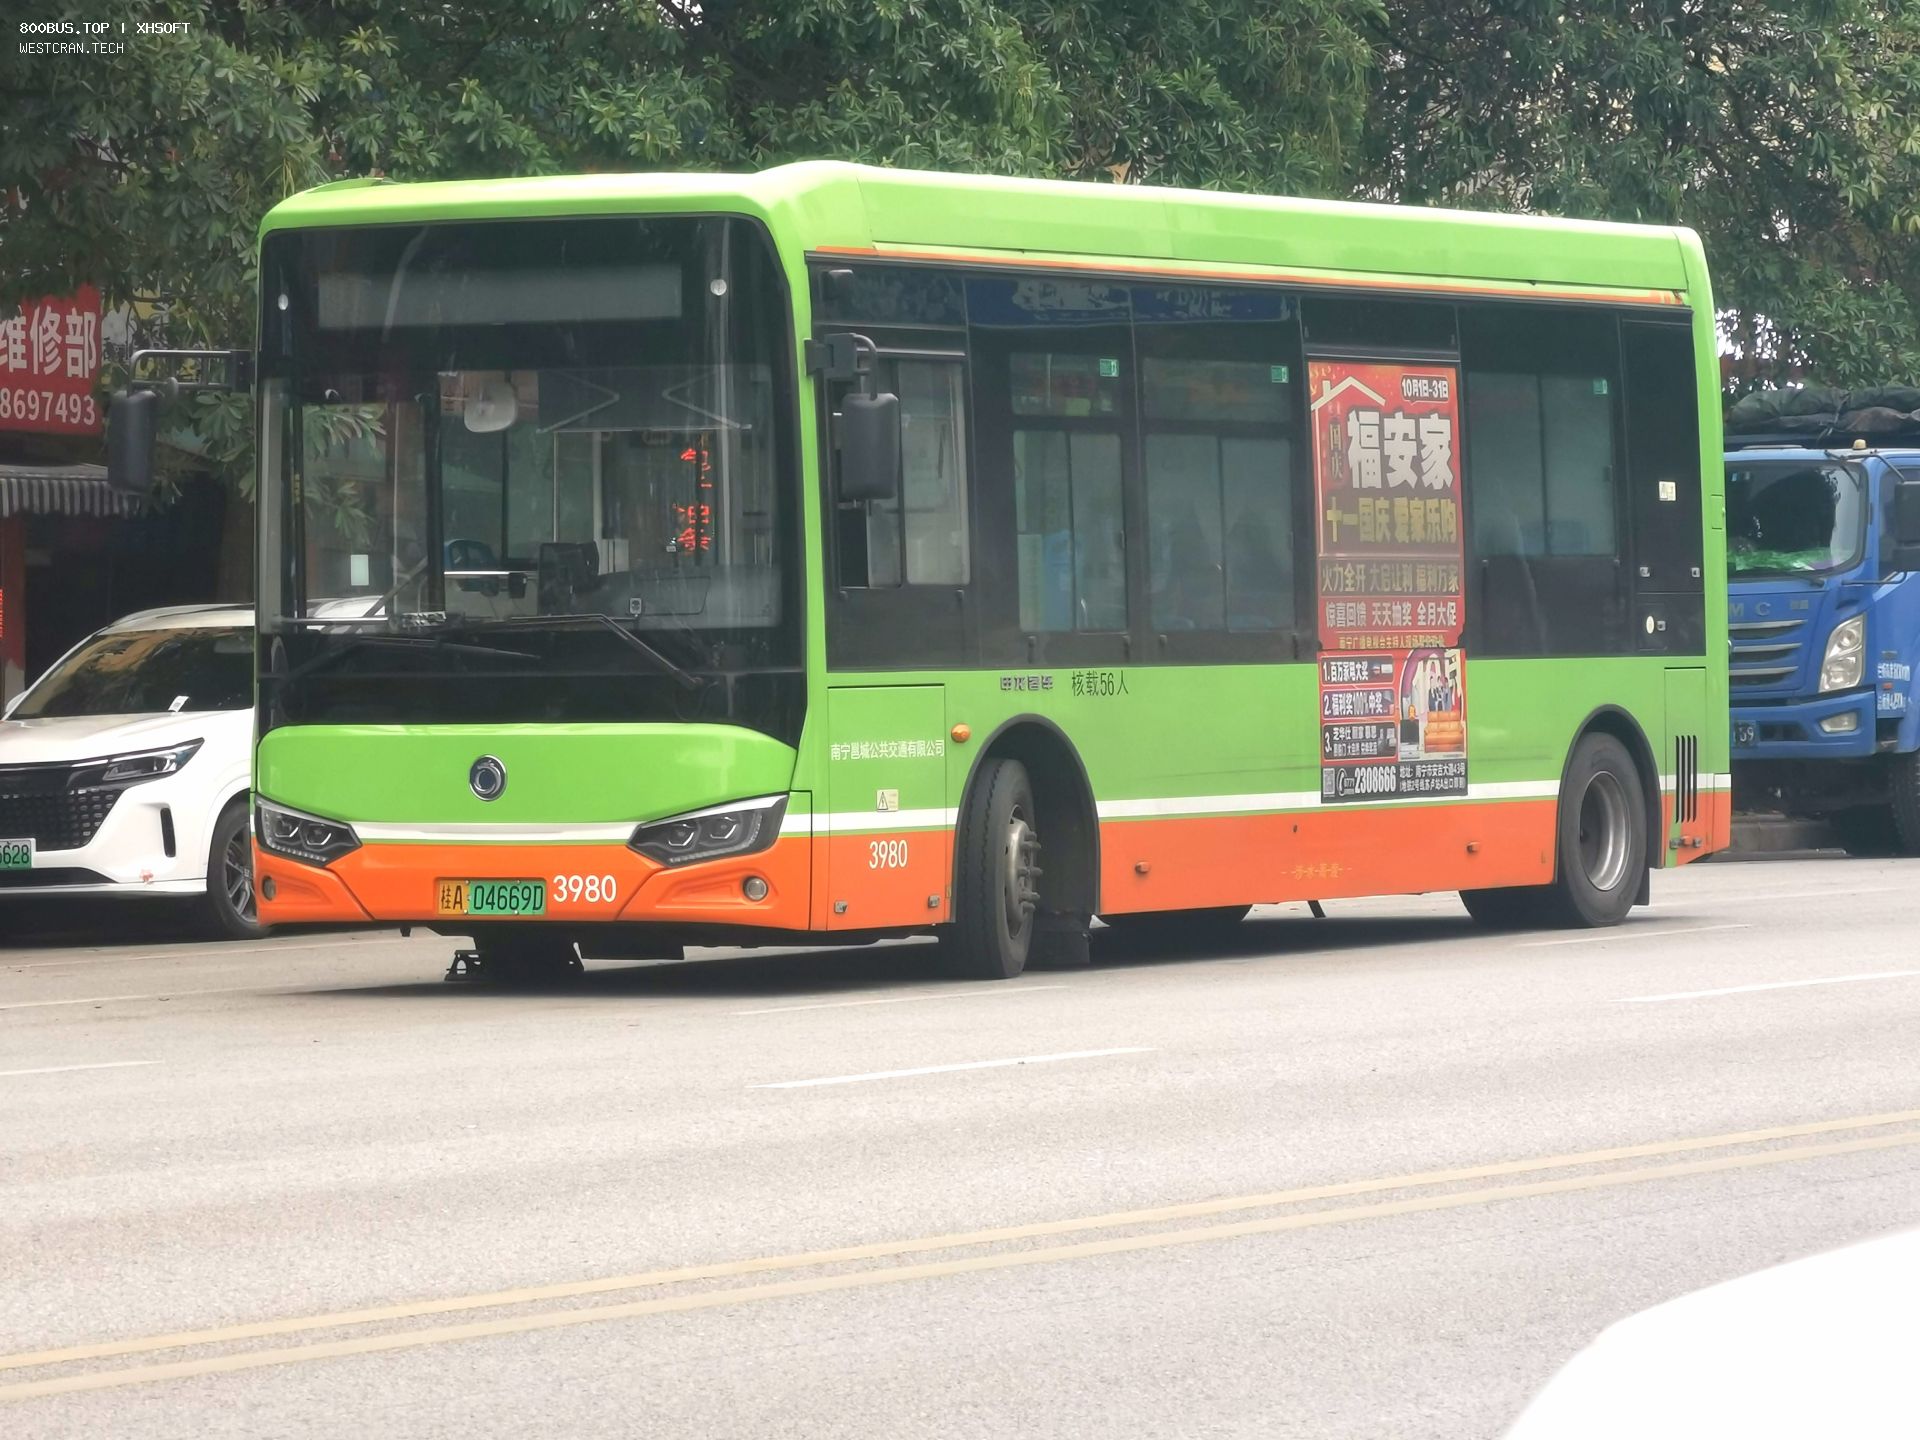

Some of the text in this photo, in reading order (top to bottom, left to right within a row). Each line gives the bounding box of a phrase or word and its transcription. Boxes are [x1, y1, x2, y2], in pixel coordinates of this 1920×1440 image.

[0, 305, 97, 378] 维修部
[0, 387, 96, 426] 8697493
[1347, 409, 1454, 490] 福安家
[1322, 563, 1366, 592] 火力全开
[1372, 602, 1412, 626] 天天抽奖
[1417, 601, 1457, 626] 全月大促
[1072, 670, 1129, 697] 核载56人
[831, 739, 944, 760] 南宁邕城公共交通有限公司
[1354, 766, 1396, 793] 2308666
[869, 840, 908, 869] 3980
[552, 875, 617, 902] 3980
